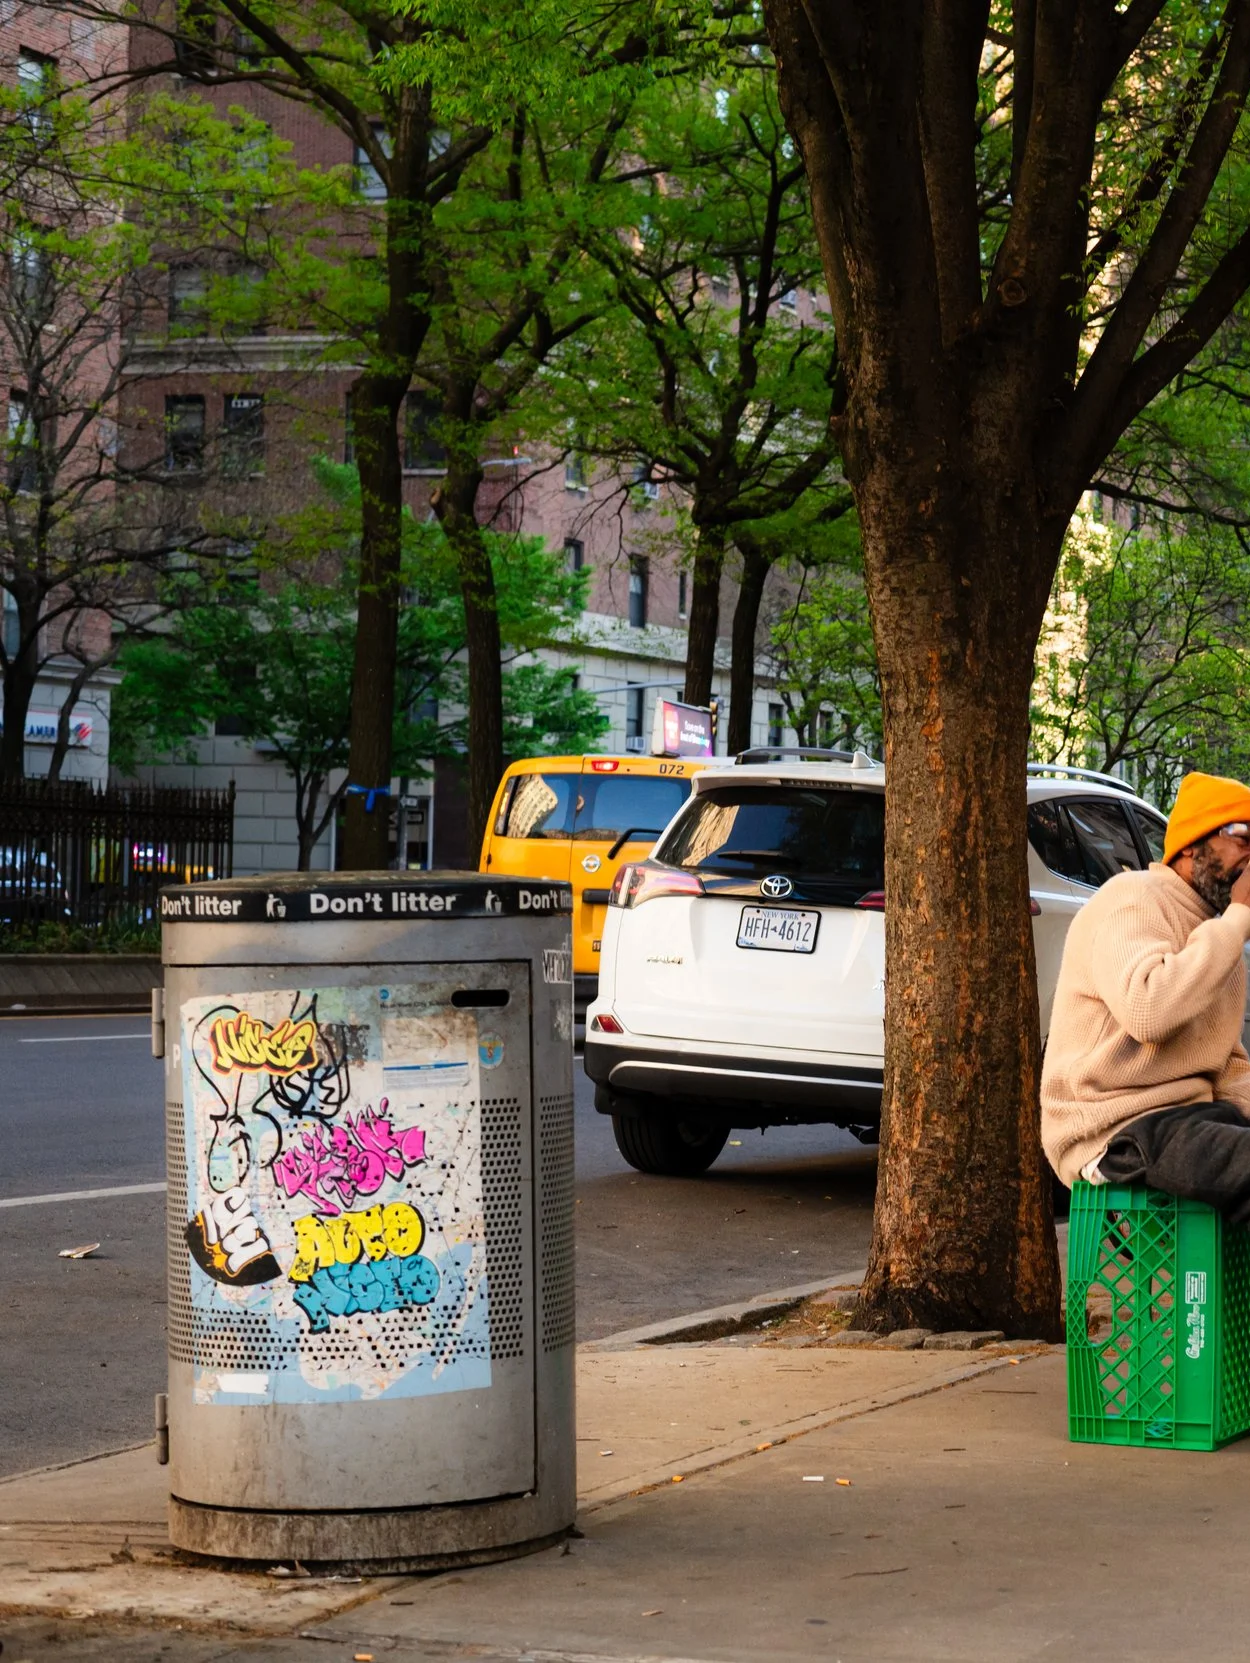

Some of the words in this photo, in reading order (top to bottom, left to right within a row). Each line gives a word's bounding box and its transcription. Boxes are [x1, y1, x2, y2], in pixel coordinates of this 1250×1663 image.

[660, 764, 684, 775] 072
[162, 896, 191, 915] Don't
[195, 895, 242, 915] litter
[310, 892, 383, 913] Don't
[392, 892, 456, 912] litter
[519, 890, 558, 910] Don't
[780, 912, 799, 920] YORK
